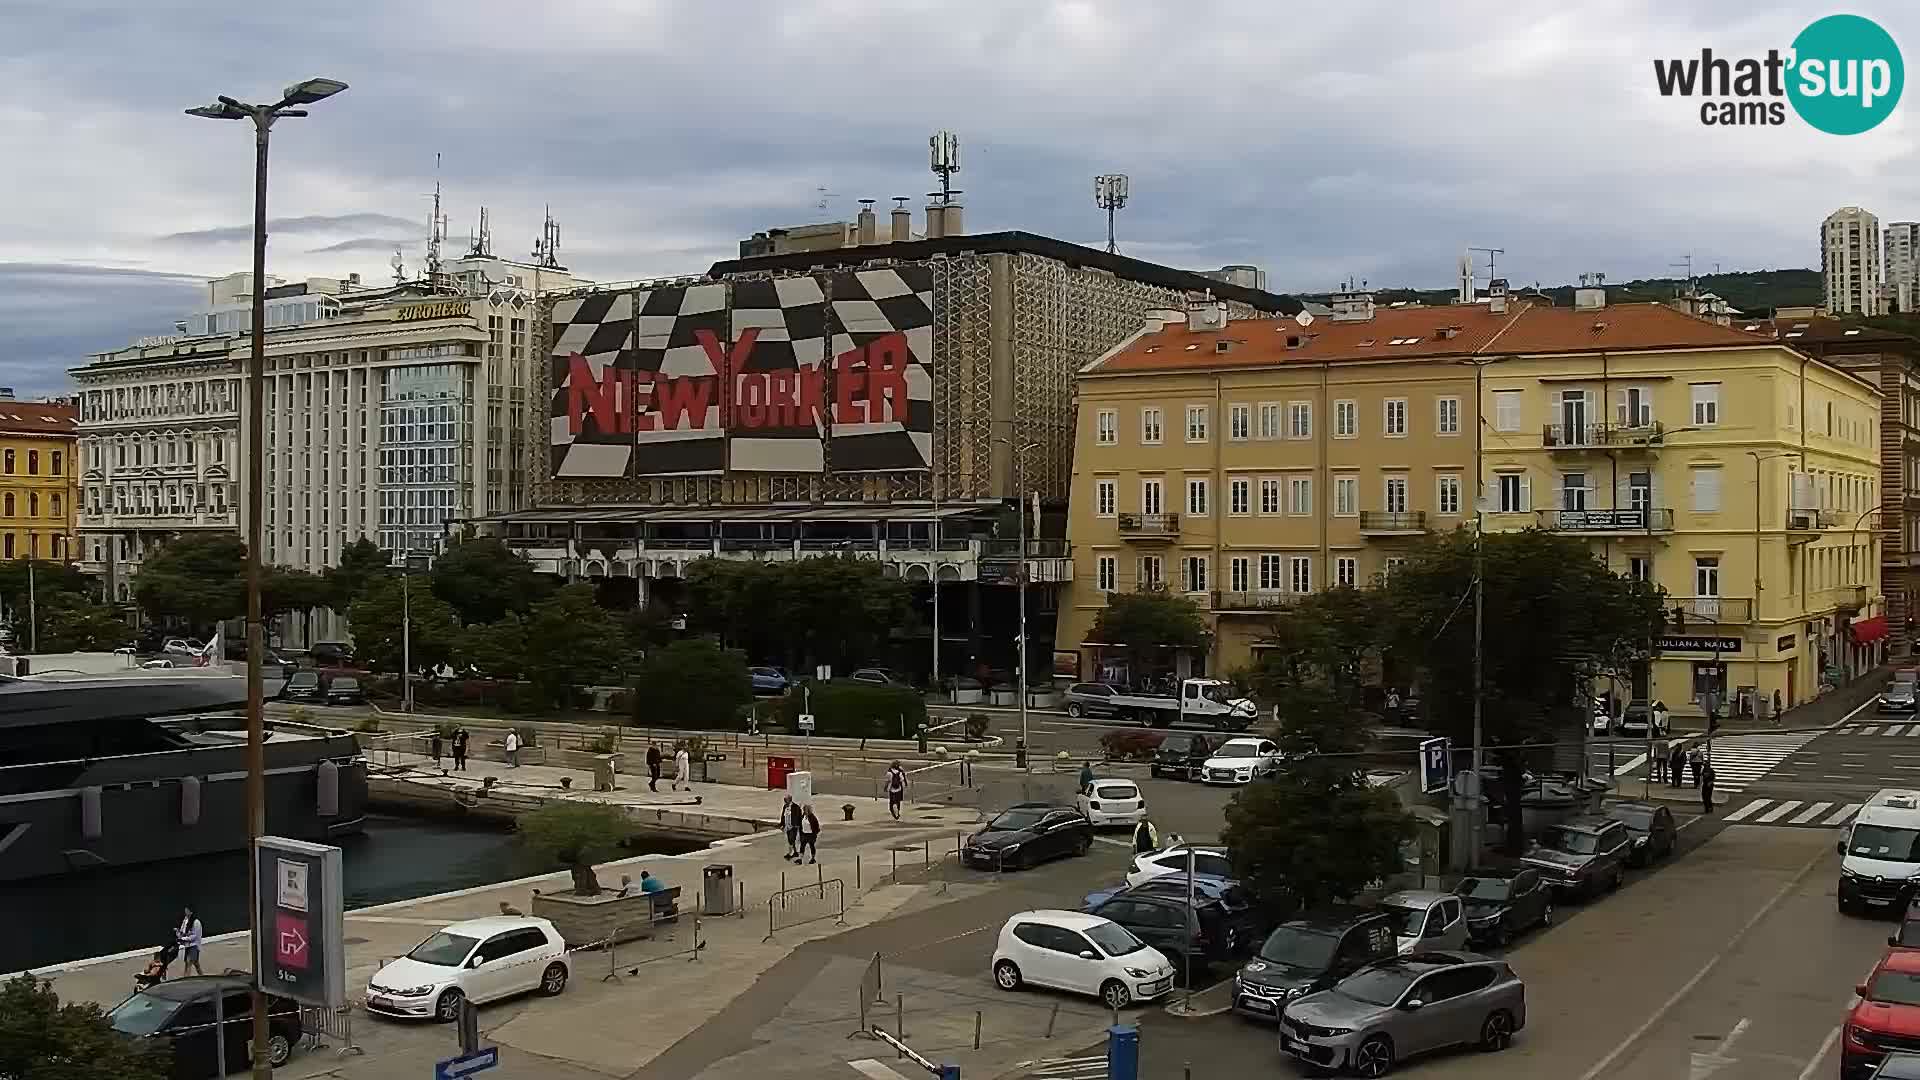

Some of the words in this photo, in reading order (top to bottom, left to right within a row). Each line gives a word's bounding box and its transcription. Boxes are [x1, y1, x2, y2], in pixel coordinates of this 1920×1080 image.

[1704, 641, 1736, 649] NAILS
[277, 969, 284, 980] 5
[284, 970, 297, 983] km
